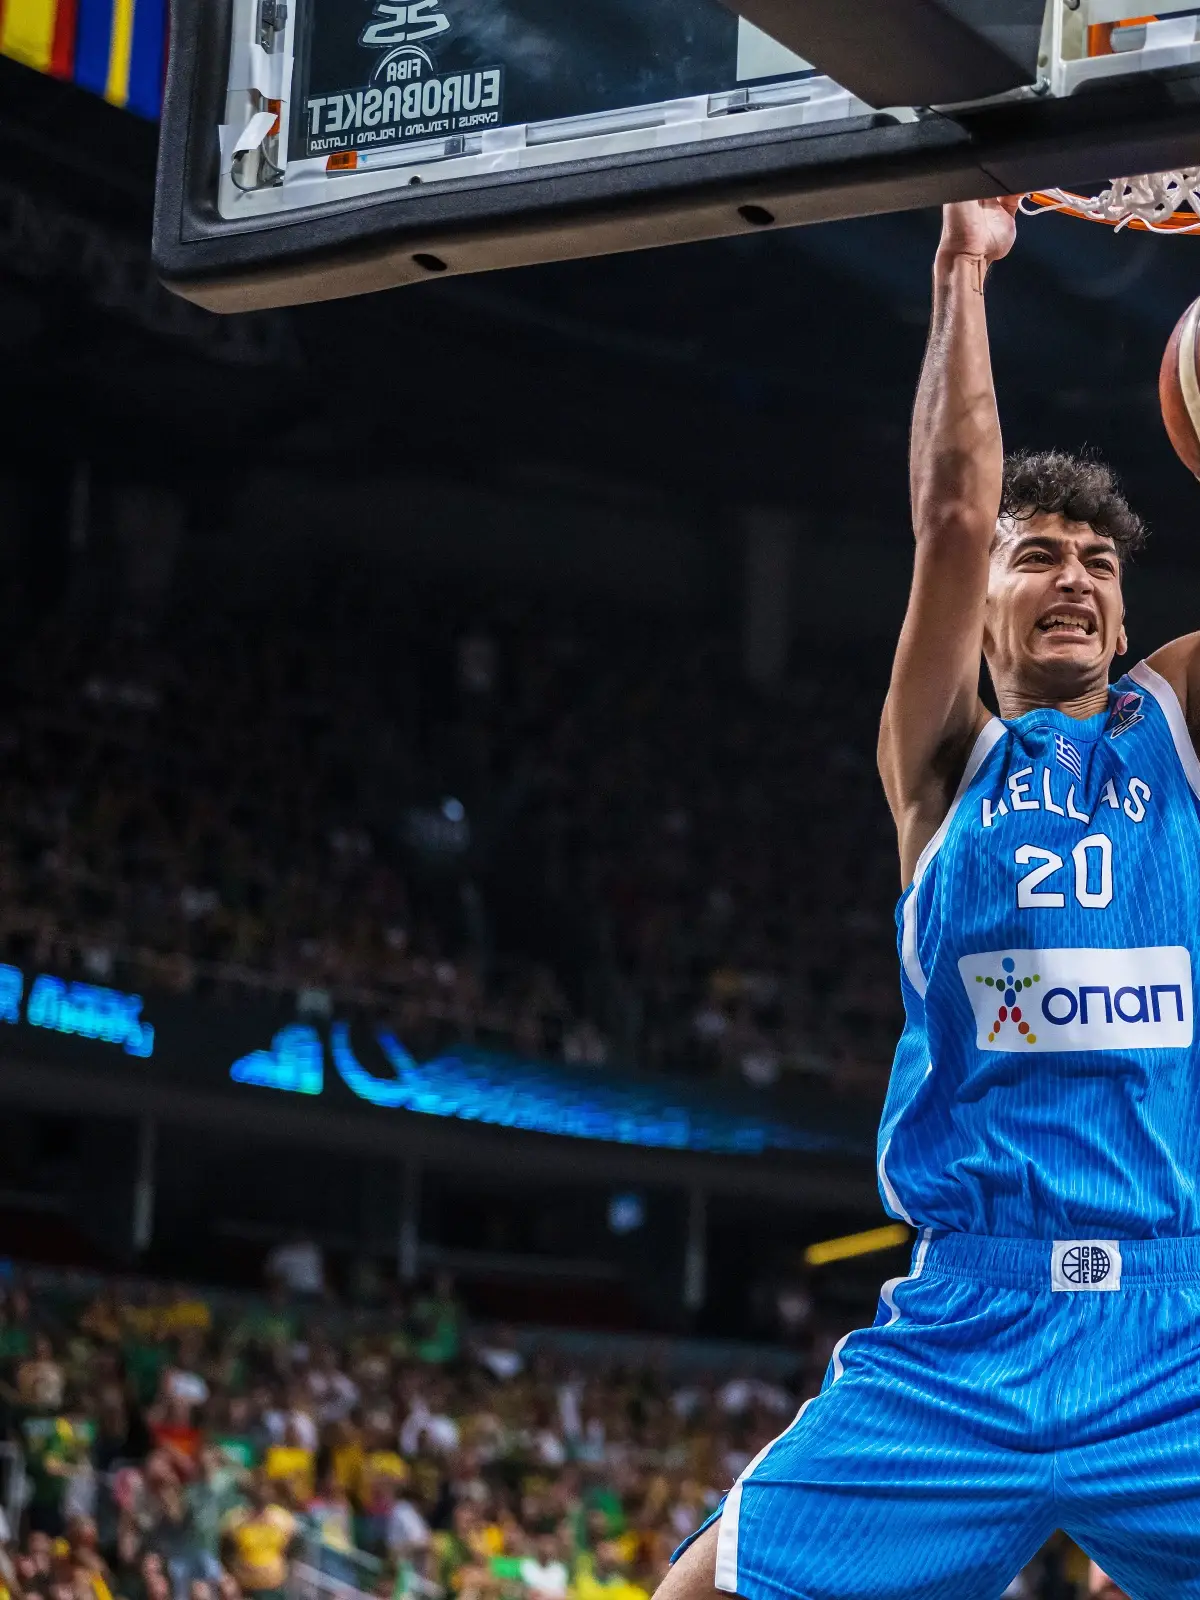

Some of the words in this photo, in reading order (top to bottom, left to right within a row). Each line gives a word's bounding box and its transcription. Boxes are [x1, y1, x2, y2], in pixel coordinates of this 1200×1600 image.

[981, 766, 1152, 828] HELLAS
[1014, 833, 1113, 910] 20
[1081, 1246, 1091, 1284] GRE
